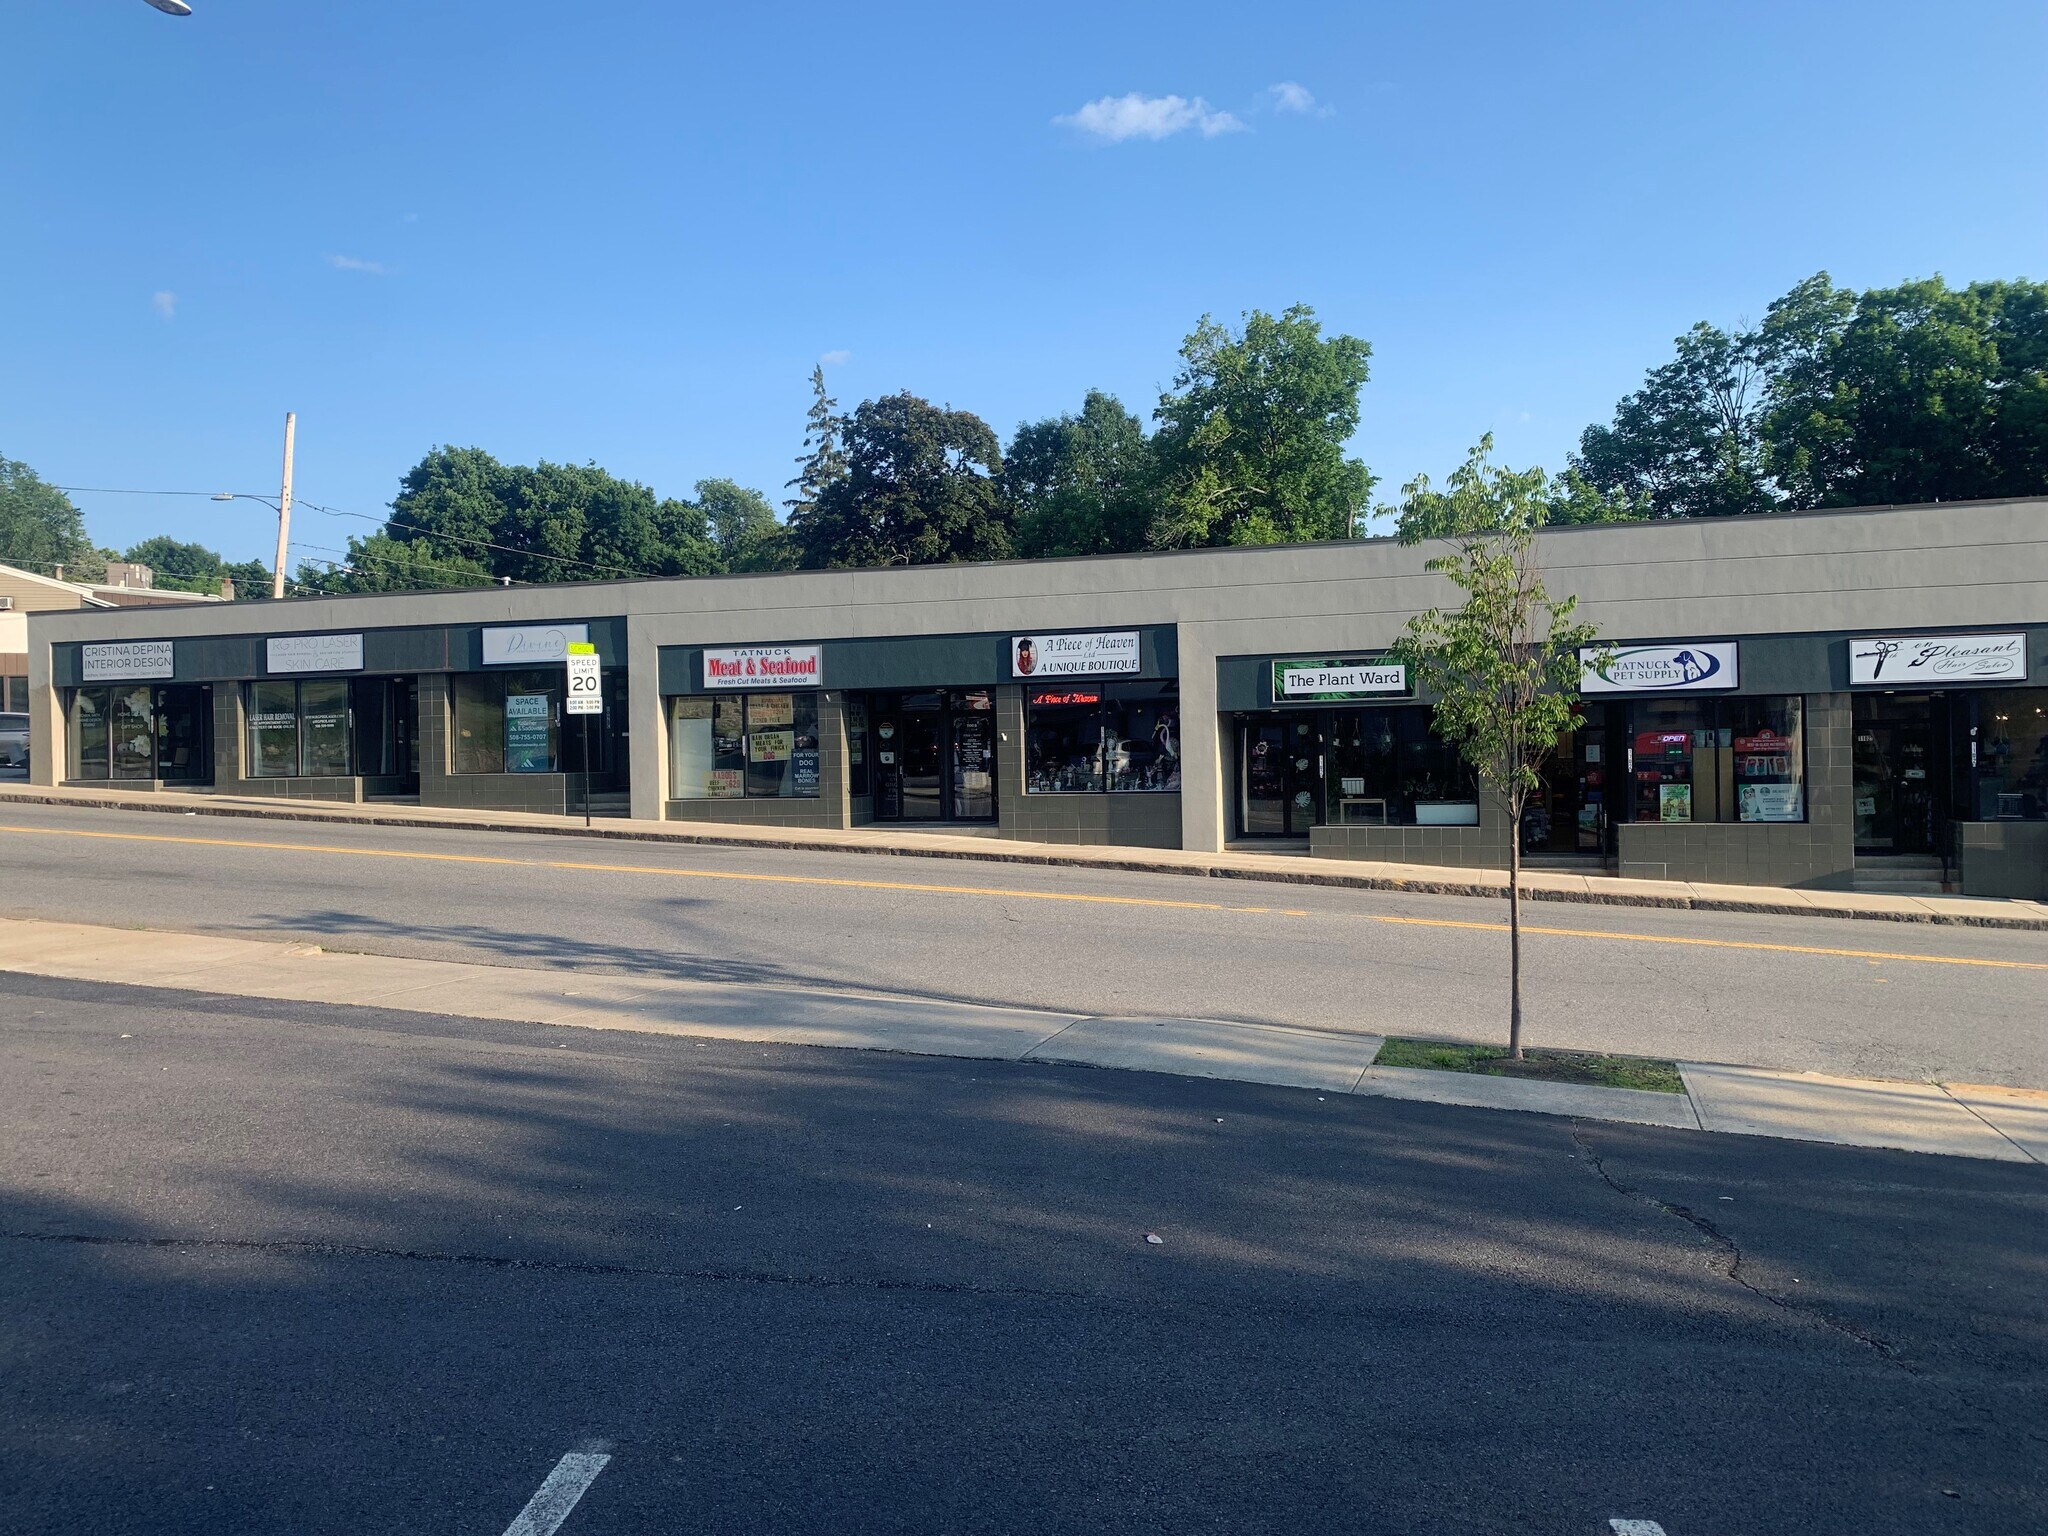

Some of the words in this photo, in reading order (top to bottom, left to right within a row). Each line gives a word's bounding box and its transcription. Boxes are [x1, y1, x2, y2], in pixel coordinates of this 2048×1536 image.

[272, 639, 290, 650] RG
[294, 638, 318, 650] PRO
[322, 636, 358, 648] LASER
[505, 633, 562, 655] Divine
[1045, 640, 1053, 652] A
[1056, 638, 1082, 651] Piece
[1085, 638, 1094, 650] of
[1096, 635, 1134, 649] Heaven
[84, 646, 130, 656] CRISTINA
[132, 644, 172, 655] DEPINA
[1908, 640, 2021, 668] Pleasant
[84, 658, 132, 669] INTERIOR
[134, 657, 172, 667] DESIGN
[286, 659, 310, 671] SKIN
[314, 657, 344, 669] CARE
[708, 658, 742, 677] Meat
[746, 657, 756, 676] &
[760, 655, 817, 676] Seafood
[1041, 664, 1047, 672] A
[1049, 662, 1086, 672] UNIQUE
[1088, 659, 1137, 671] BOUTIQUE
[1616, 660, 1671, 670] TATNUCK
[1938, 660, 1966, 670] Hair
[1975, 660, 2009, 670] Salon
[1289, 674, 1314, 686] The
[1318, 673, 1354, 686] Plant
[1359, 671, 1400, 684] Ward
[1613, 672, 1636, 680] PET
[1638, 669, 1681, 679] SUPPLY
[573, 676, 597, 691] 20
[275, 712, 295, 720] REMOVAL
[763, 752, 775, 760] DOG
